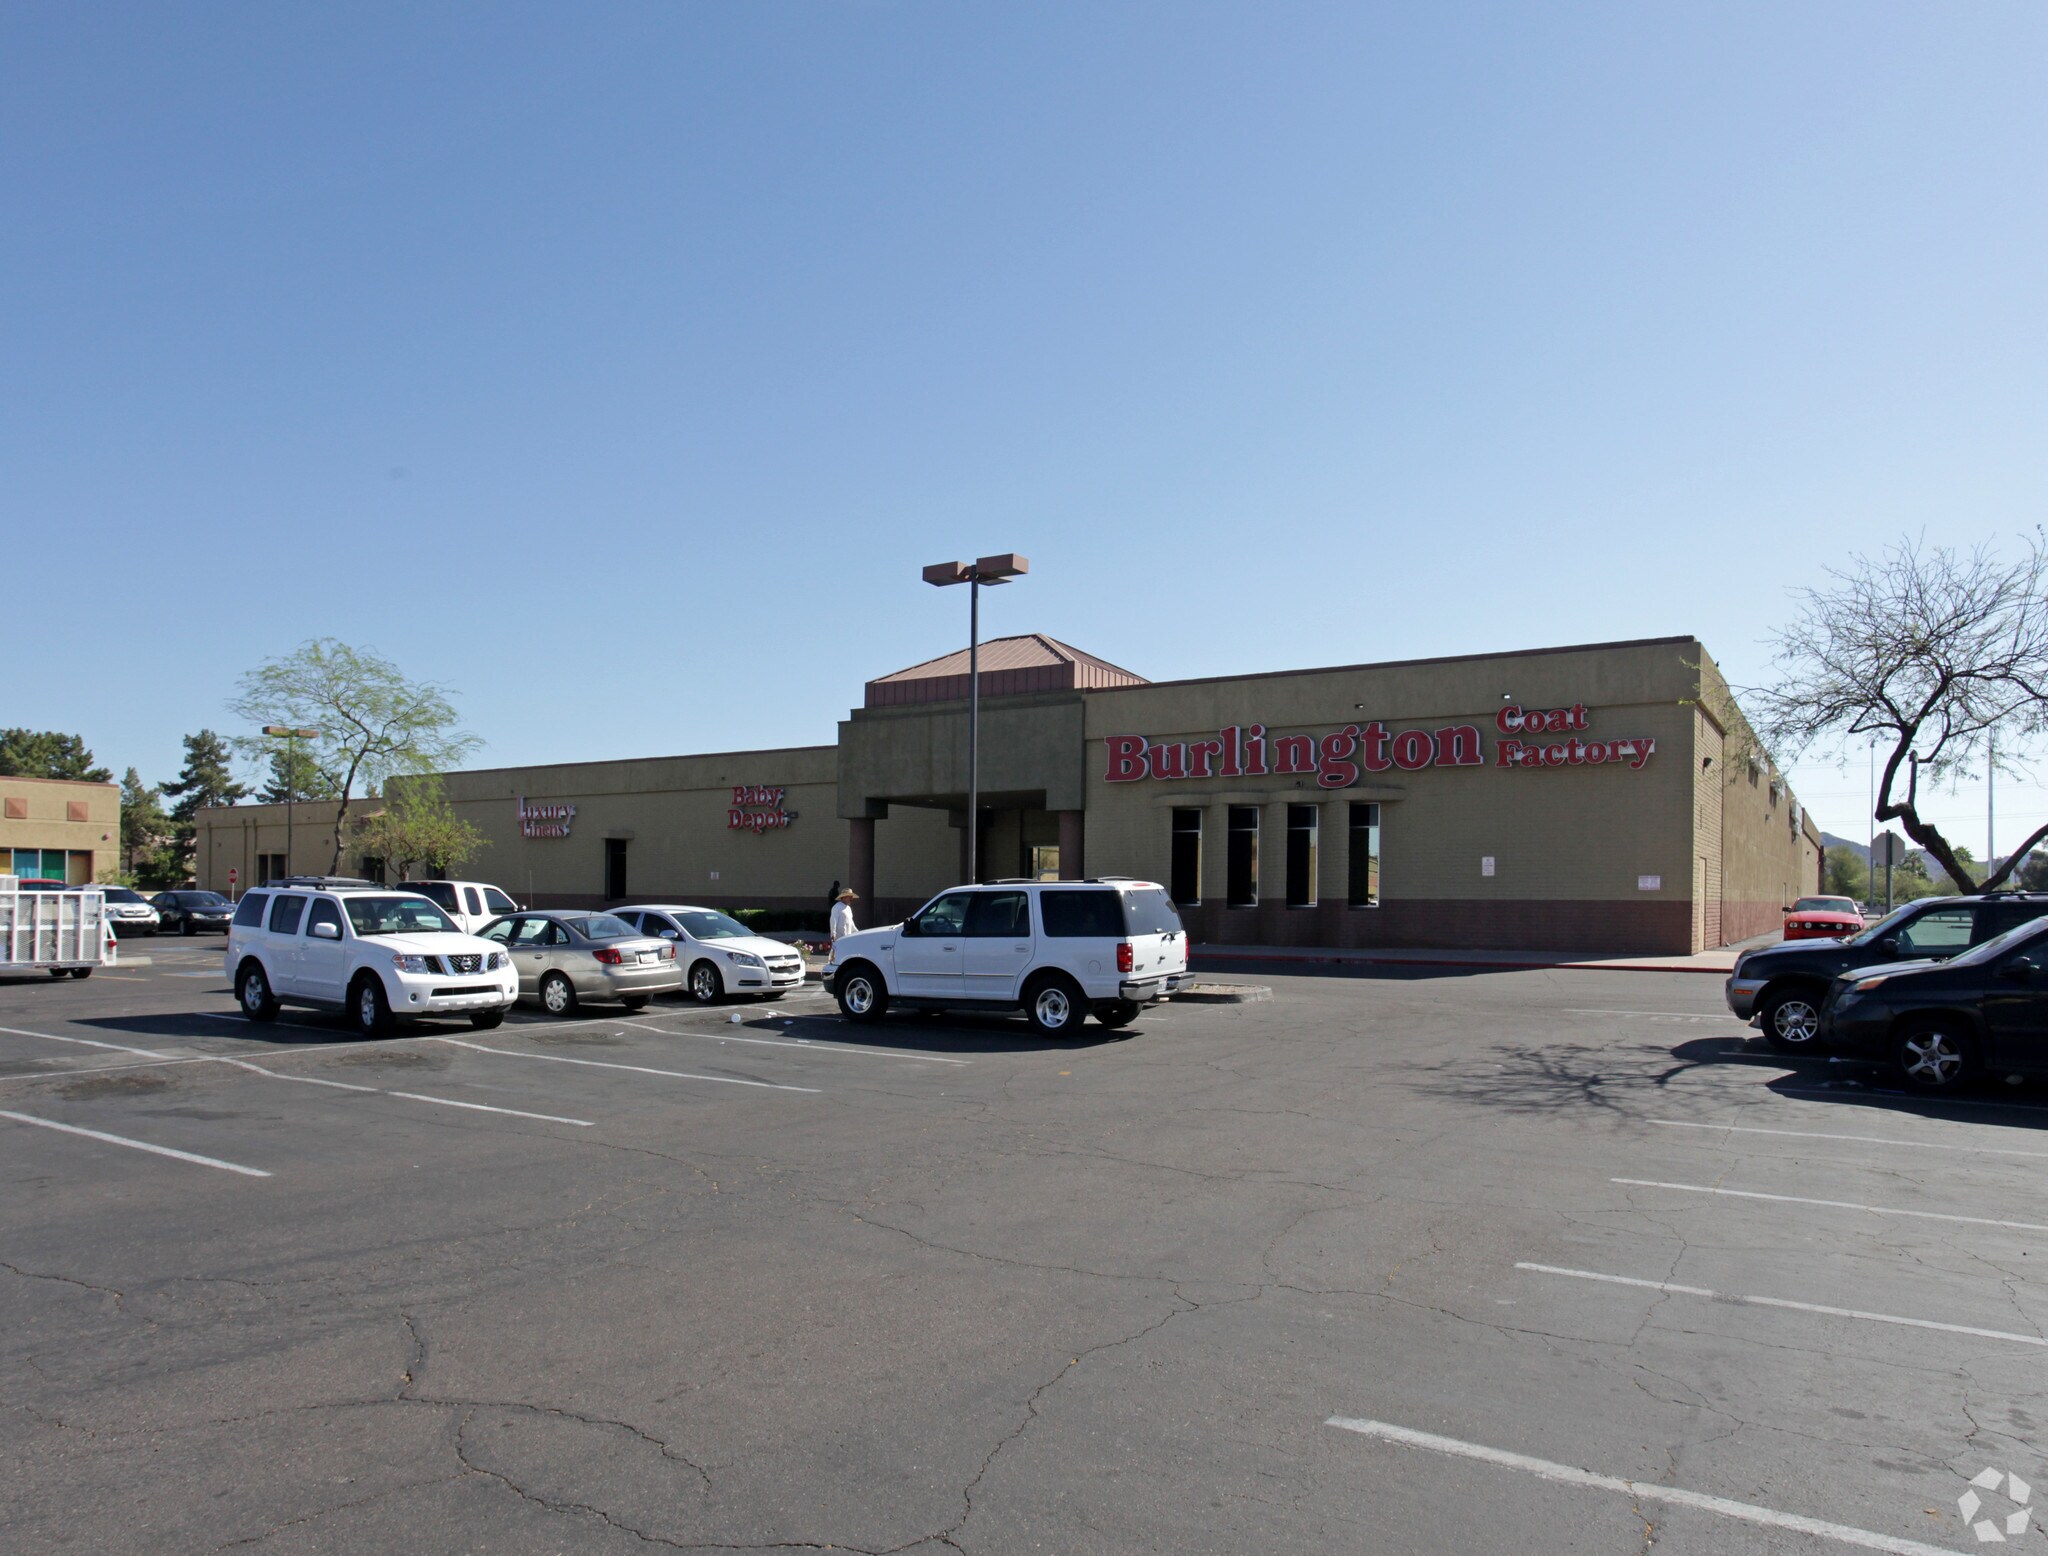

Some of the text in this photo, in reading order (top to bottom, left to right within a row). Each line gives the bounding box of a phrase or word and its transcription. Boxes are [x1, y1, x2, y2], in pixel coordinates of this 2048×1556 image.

[1496, 703, 1589, 734] Coat
[1103, 721, 1484, 789] Burlington
[1495, 737, 1656, 769] Factory
[517, 796, 576, 824] Luxury
[732, 785, 784, 810] Baby
[521, 820, 570, 837] Linens
[727, 808, 788, 834] Depot
